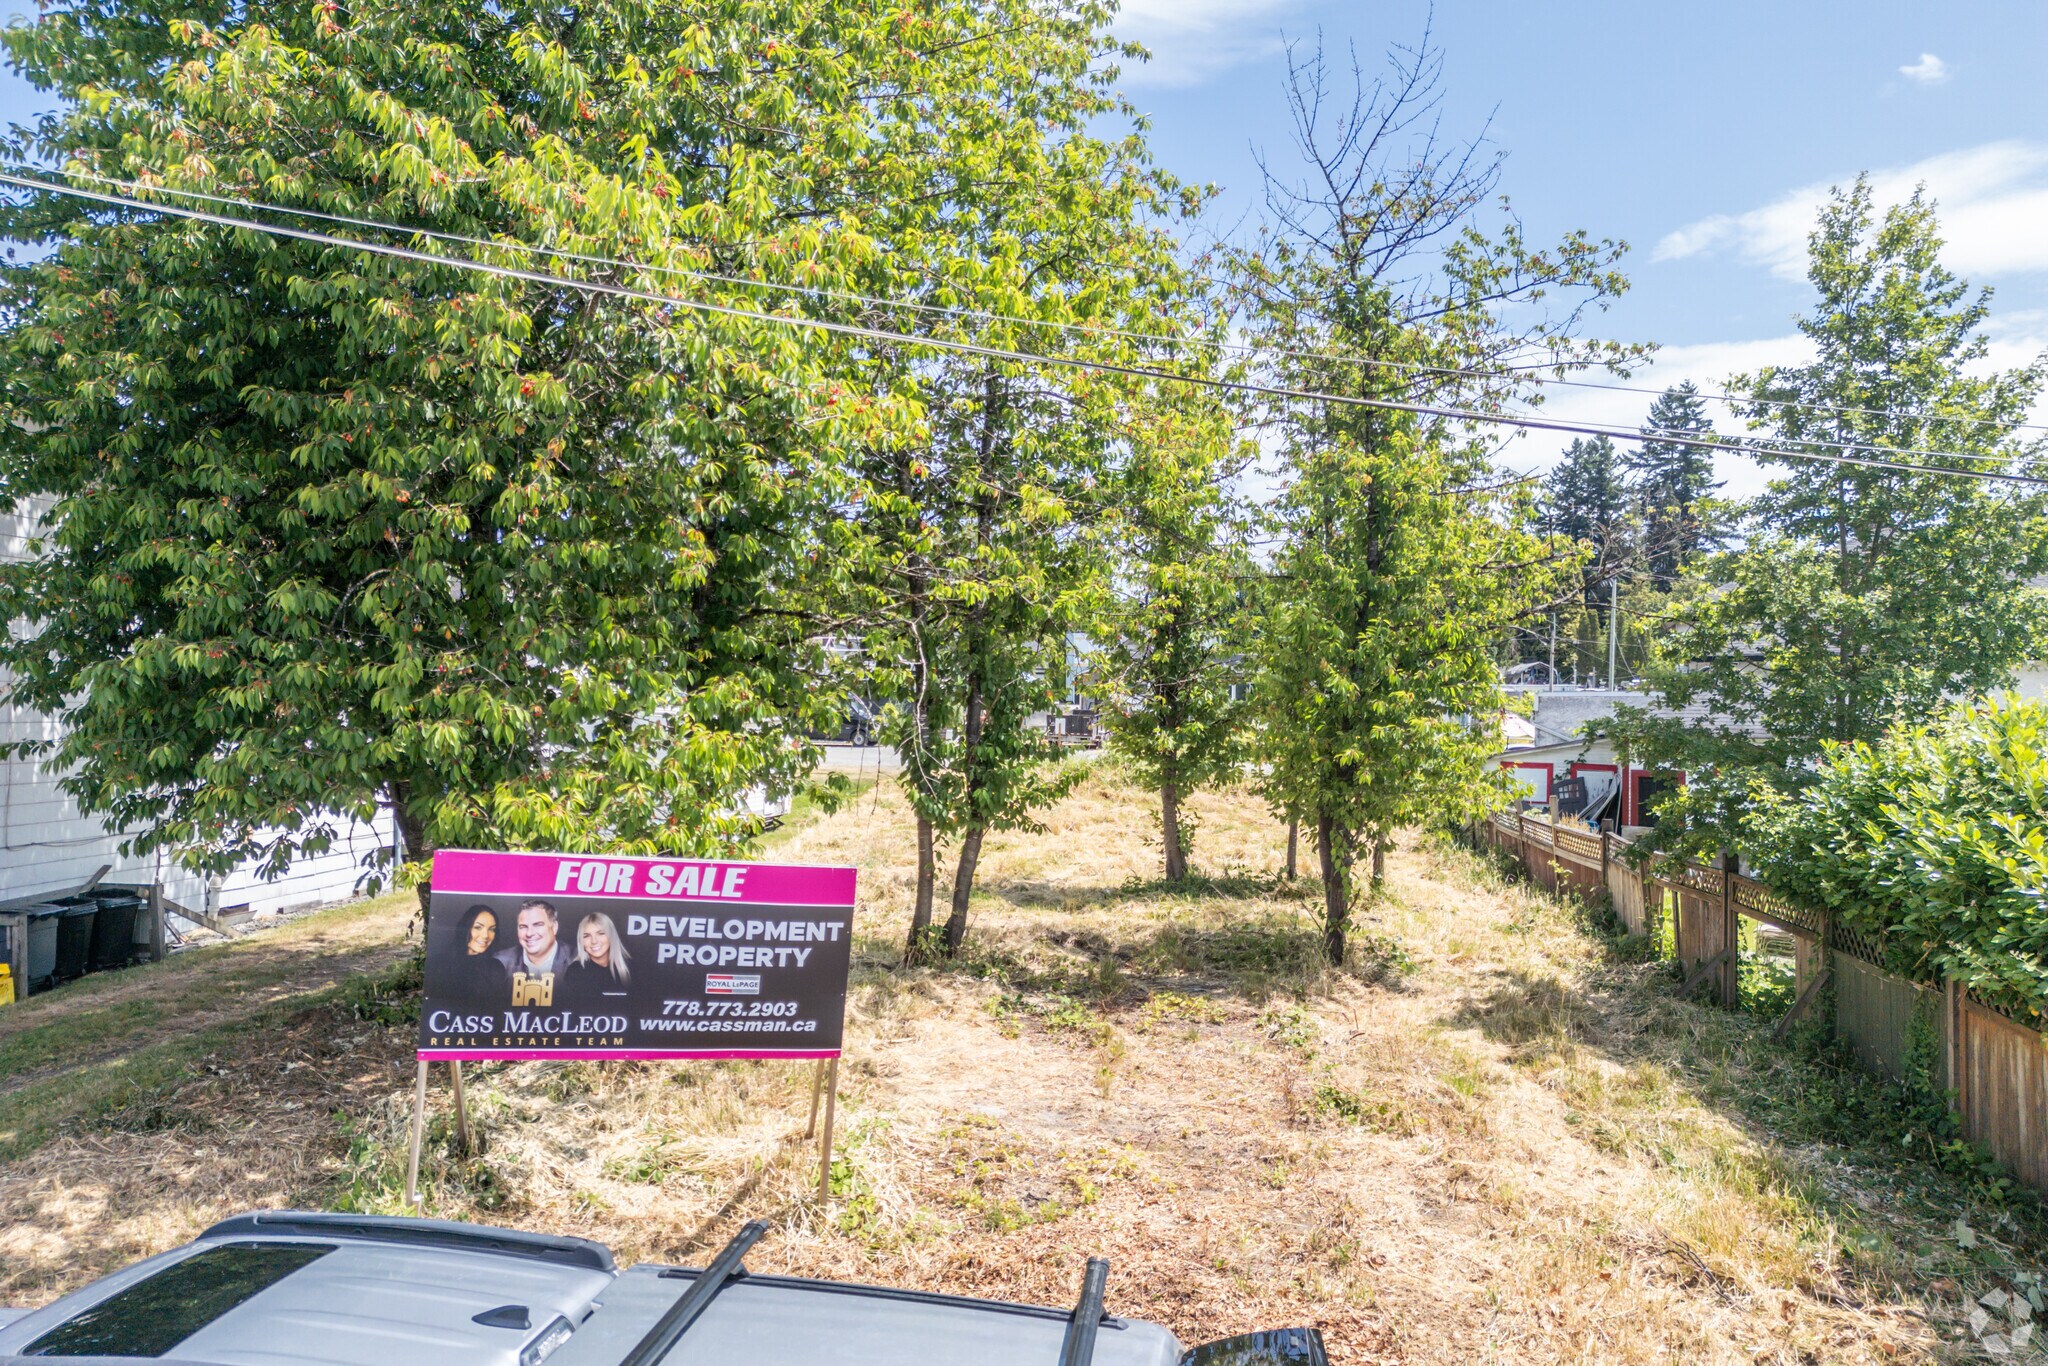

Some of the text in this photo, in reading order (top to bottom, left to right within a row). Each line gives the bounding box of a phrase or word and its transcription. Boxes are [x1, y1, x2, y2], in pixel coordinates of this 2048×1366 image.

[554, 861, 747, 898] FOR SALE
[627, 915, 844, 942] DEVELOPMENT
[657, 943, 812, 967] PROPERTY
[707, 980, 731, 988] ROYAL
[662, 1000, 798, 1017] 778.773.2903
[639, 1019, 817, 1033] www.cassman.ca
[430, 1037, 624, 1046] REAL ESTATE TEAM
